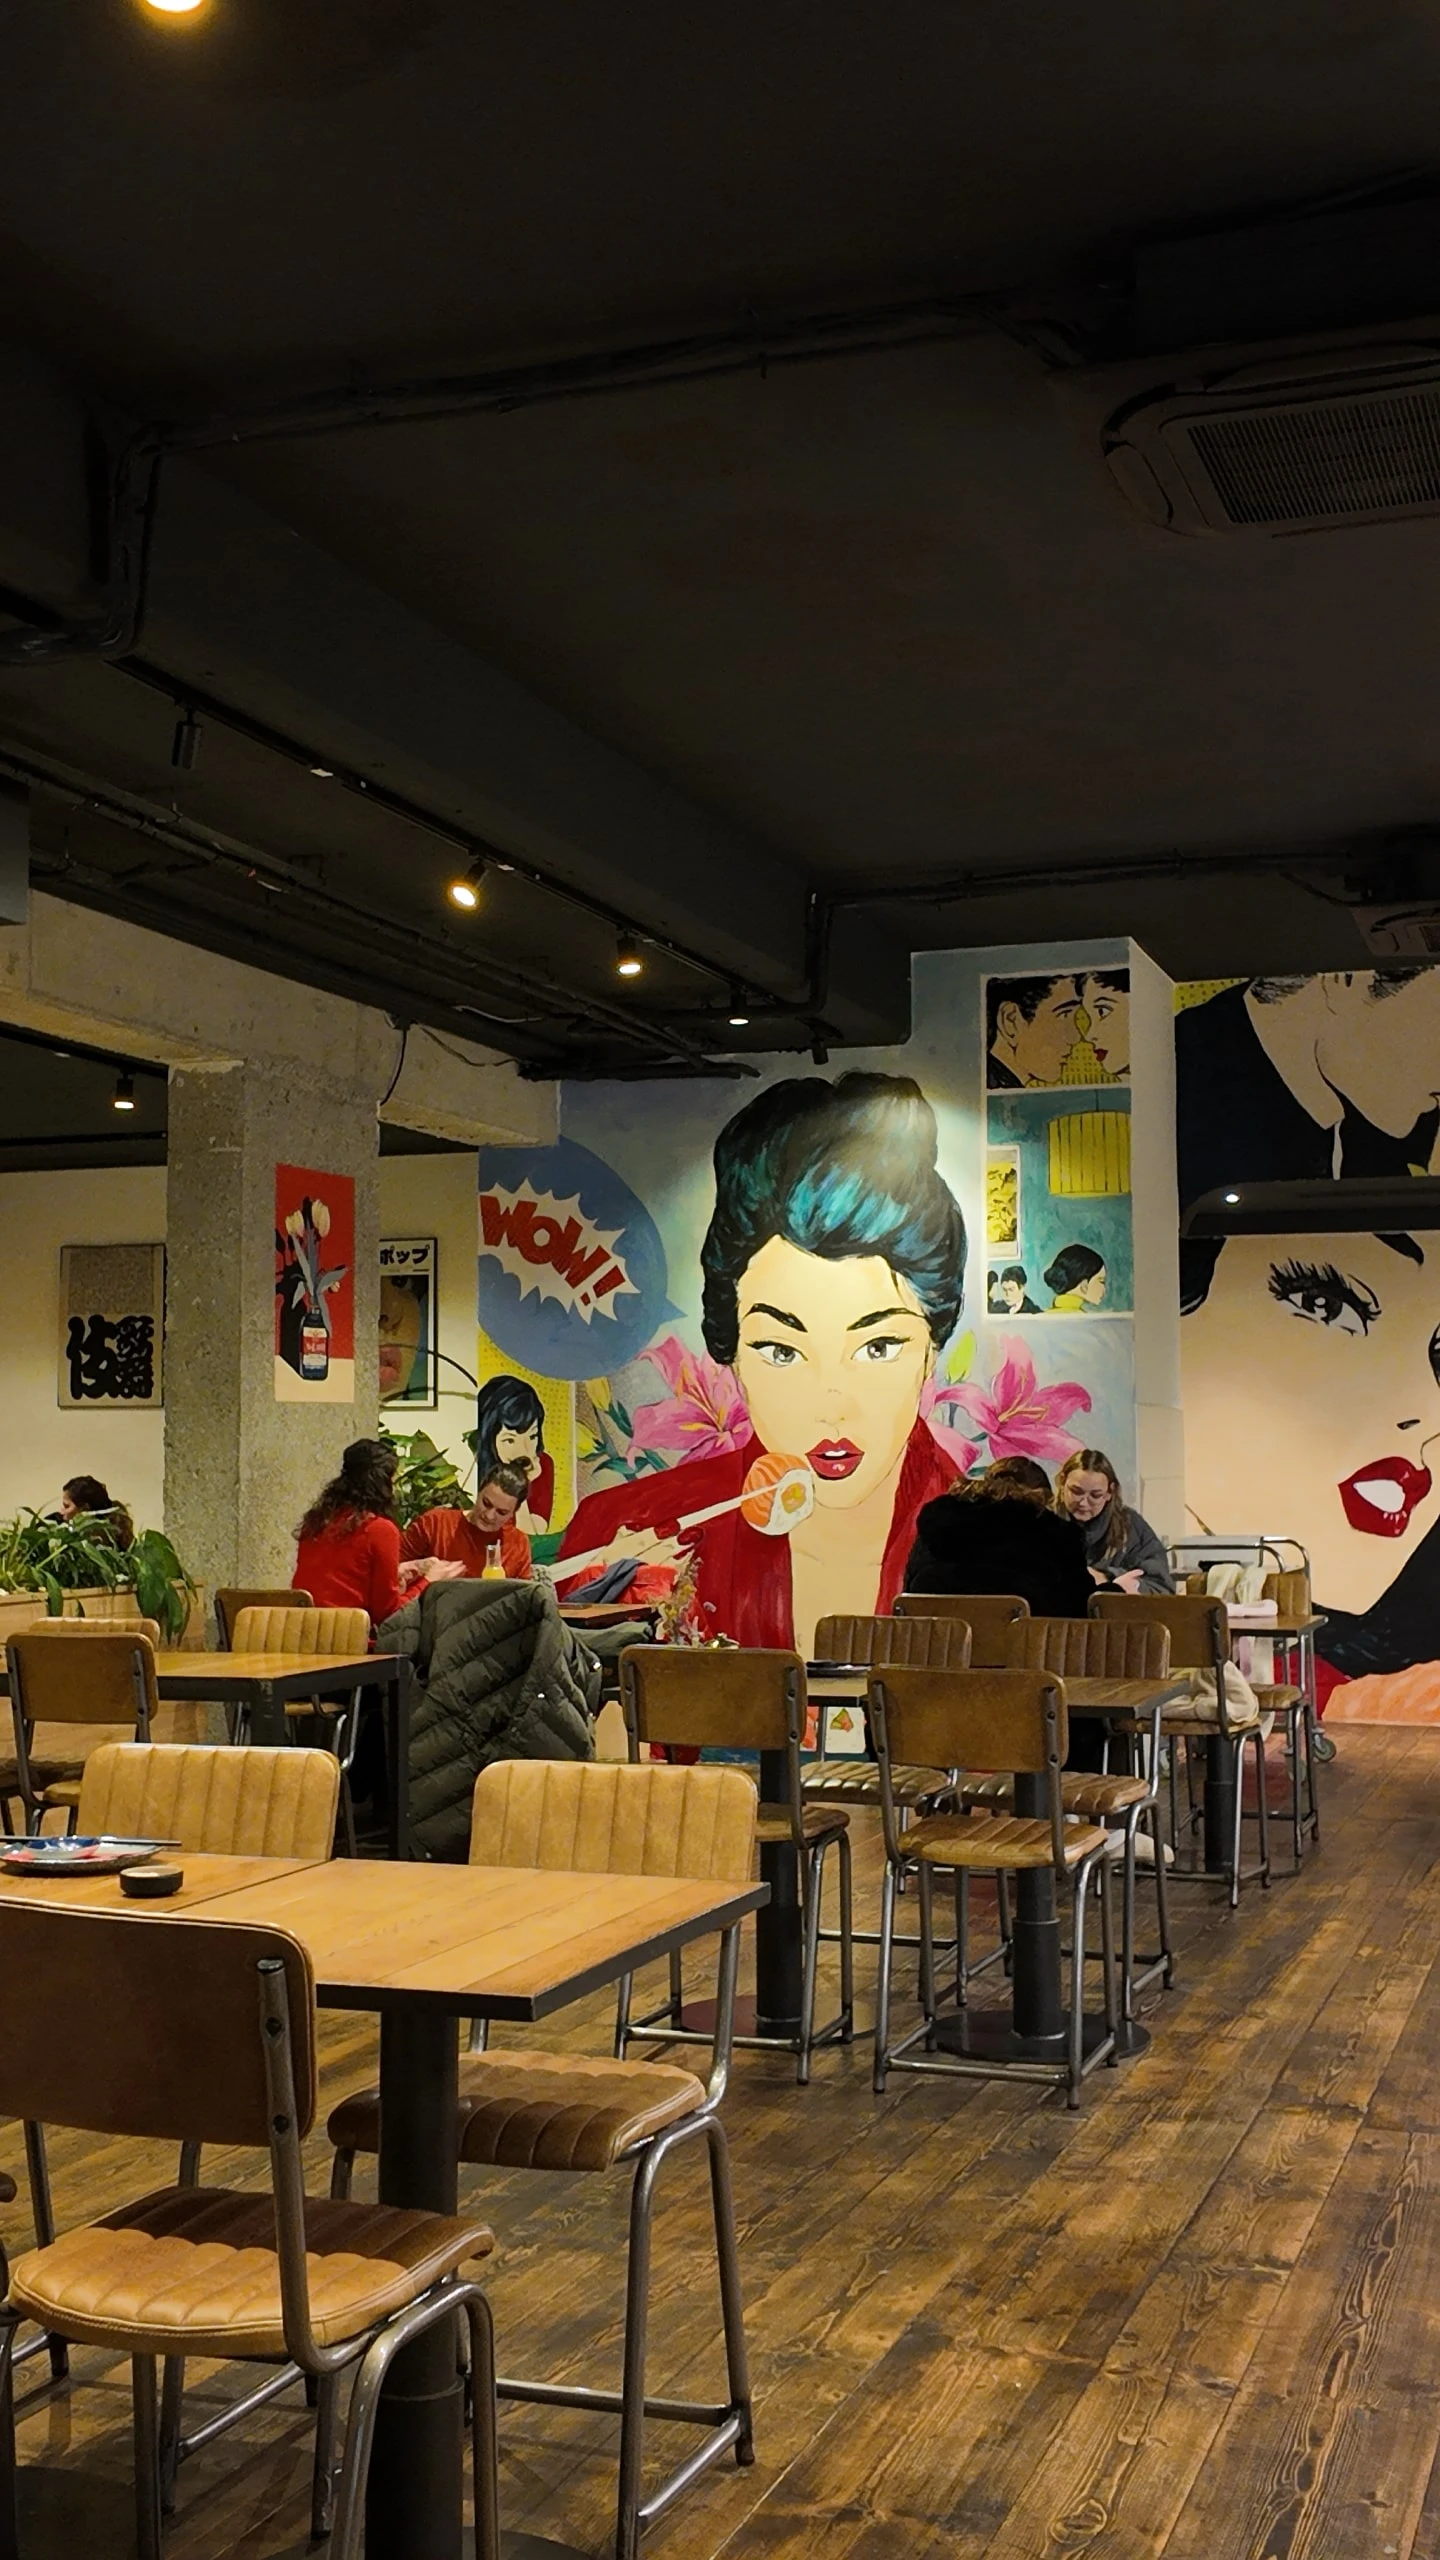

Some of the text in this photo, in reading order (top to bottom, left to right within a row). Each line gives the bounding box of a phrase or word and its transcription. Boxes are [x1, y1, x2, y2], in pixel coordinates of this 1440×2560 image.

[379, 1244, 430, 1265] ポップ
[480, 1195, 626, 1307] WOW!
